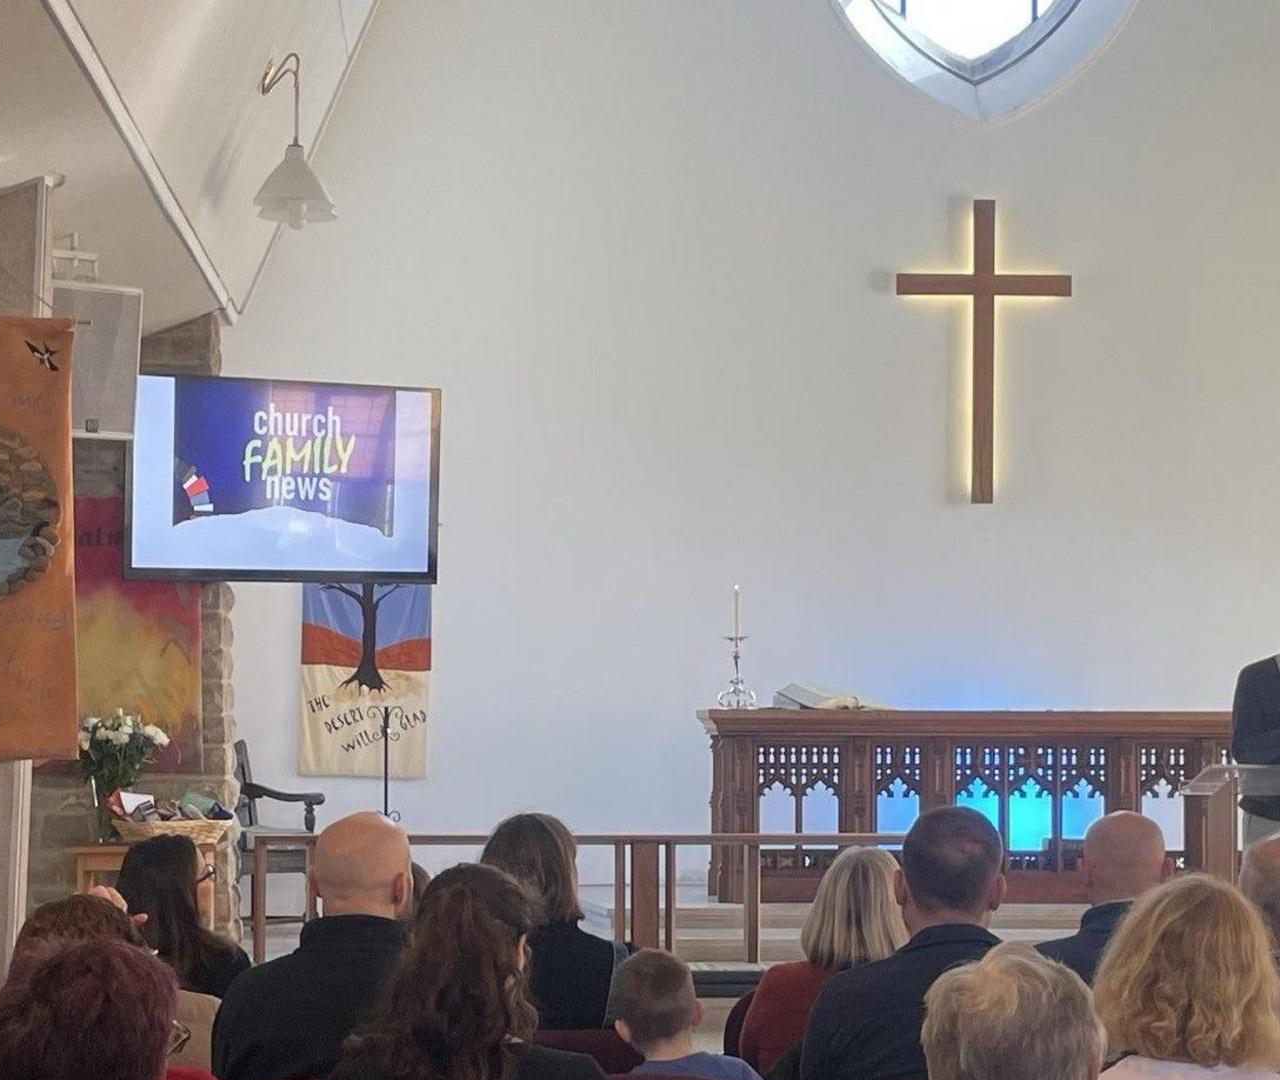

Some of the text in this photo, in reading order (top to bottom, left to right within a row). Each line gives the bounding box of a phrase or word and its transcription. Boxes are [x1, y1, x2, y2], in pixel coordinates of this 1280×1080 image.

[253, 402, 341, 438] church
[243, 433, 356, 483] FAMILY
[265, 475, 332, 501] news
[307, 694, 330, 714] THE
[324, 707, 365, 734] DESERT
[399, 709, 427, 731] GLAD
